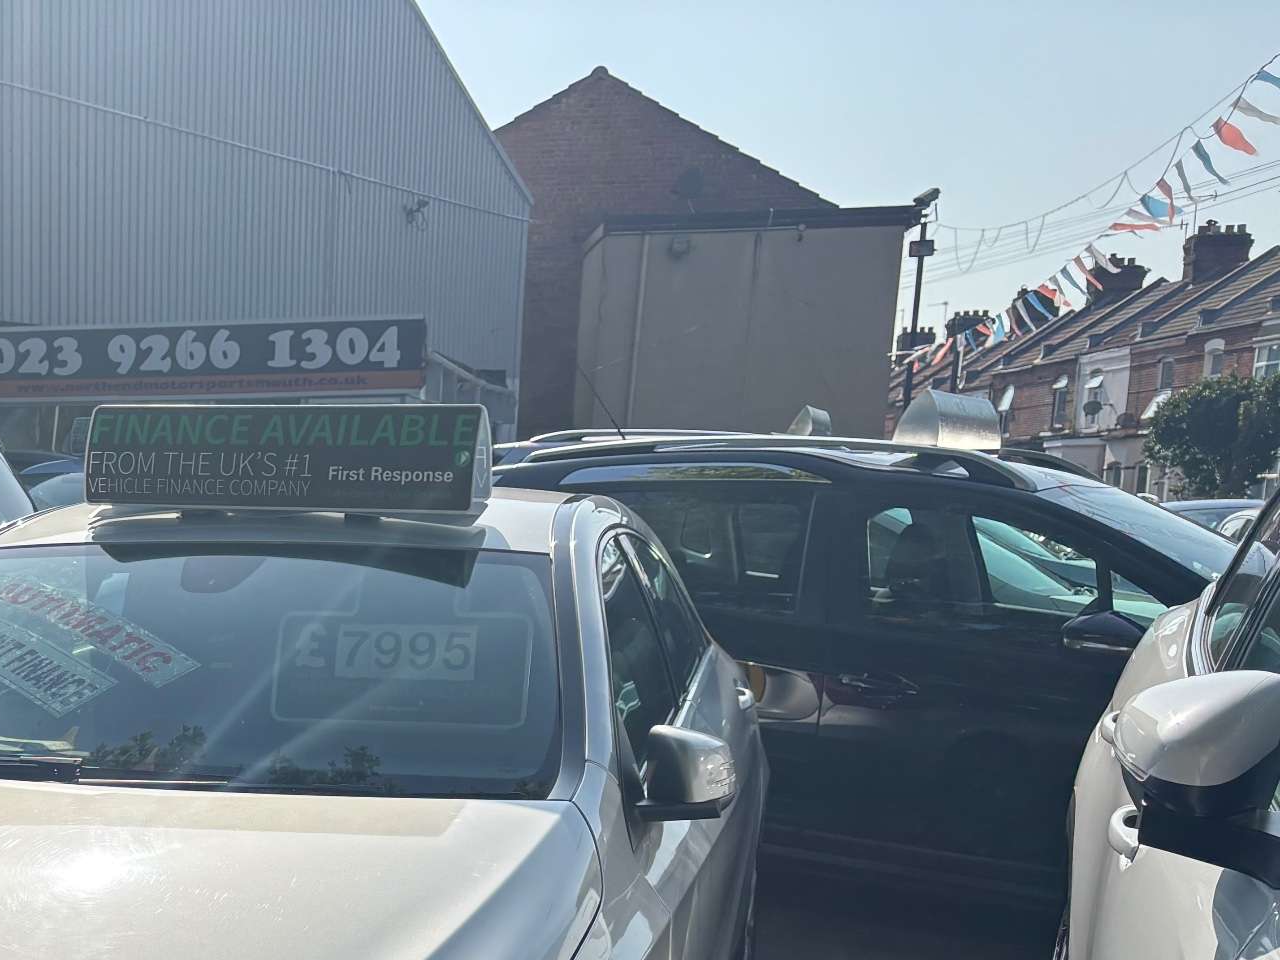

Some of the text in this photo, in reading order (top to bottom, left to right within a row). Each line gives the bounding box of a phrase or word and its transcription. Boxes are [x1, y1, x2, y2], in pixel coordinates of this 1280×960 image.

[107, 328, 241, 374] 9266
[265, 325, 401, 370] 1304
[91, 414, 479, 448] FINANCE AVAILABLE
[88, 451, 313, 478] FROM THE UK'S #1
[328, 466, 454, 486] First Response
[88, 477, 153, 495] VEHICLE
[157, 477, 225, 496] FINANCE
[229, 478, 312, 497] COMPANY
